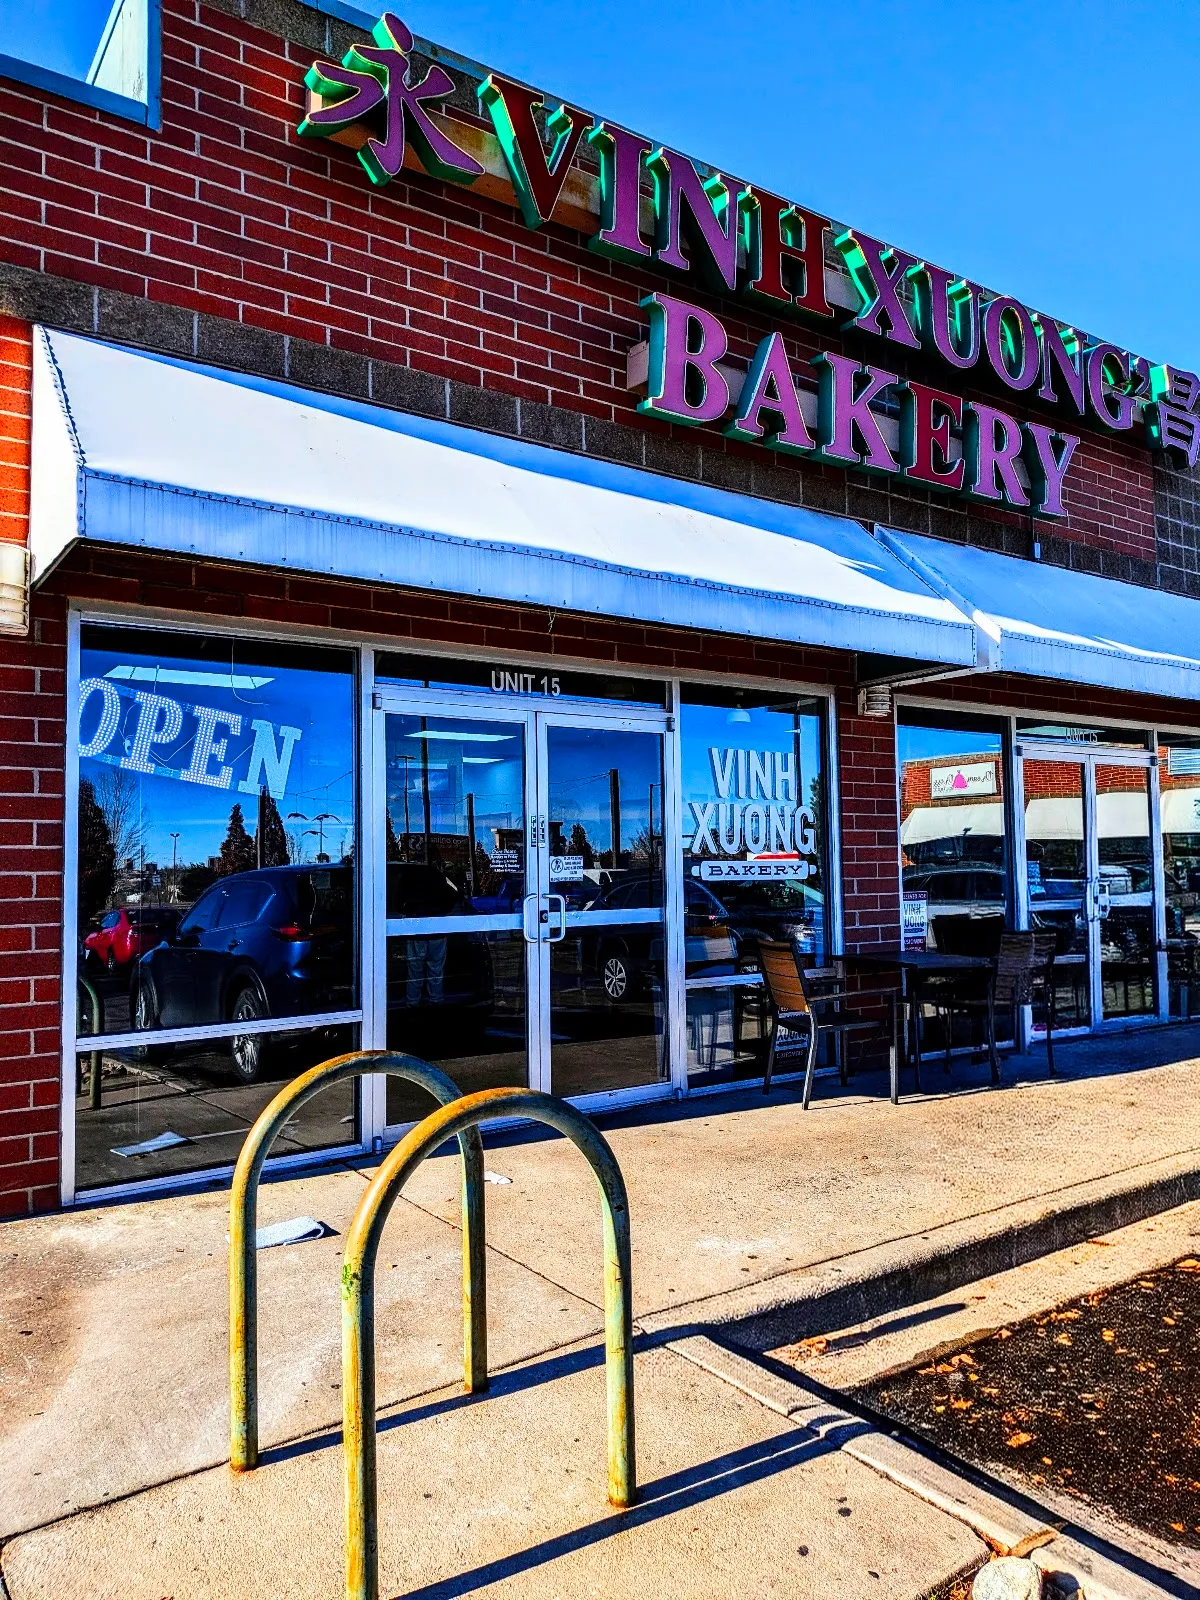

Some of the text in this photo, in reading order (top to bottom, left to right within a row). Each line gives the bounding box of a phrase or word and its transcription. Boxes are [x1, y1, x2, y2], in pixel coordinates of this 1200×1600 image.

[300, 12, 486, 182] 永
[482, 74, 835, 318] VINH
[642, 292, 1081, 518] BAKERY
[491, 670, 561, 697] UNIT 15
[77, 677, 302, 800] OPEN
[707, 747, 797, 801] VINH
[687, 802, 818, 855] XUONG
[708, 864, 803, 877] BAKERY
[904, 915, 925, 928] UONG
